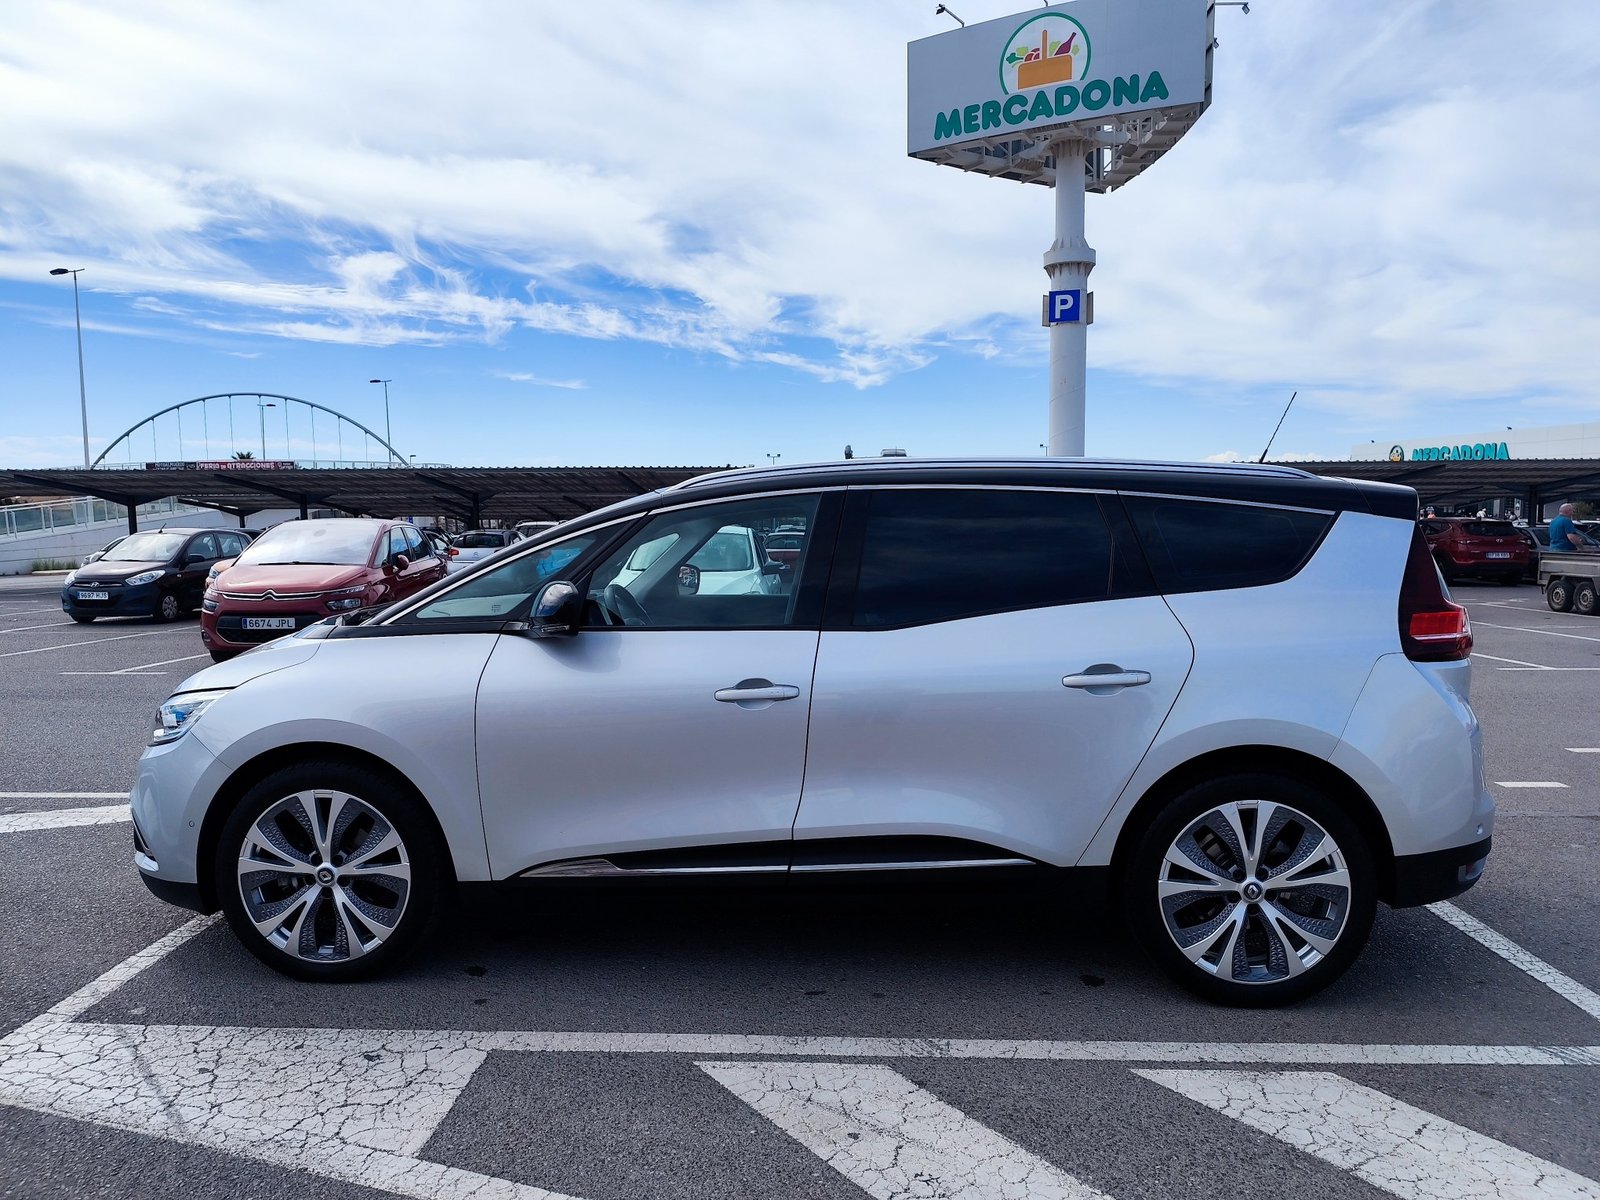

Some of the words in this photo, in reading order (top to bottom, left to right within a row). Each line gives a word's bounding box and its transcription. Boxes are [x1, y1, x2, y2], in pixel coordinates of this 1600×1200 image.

[934, 70, 1169, 140] MERCADONA
[1055, 295, 1073, 318] P
[1412, 442, 1510, 461] MERCADONA
[248, 619, 272, 628] 6674
[275, 619, 293, 628] JPL
